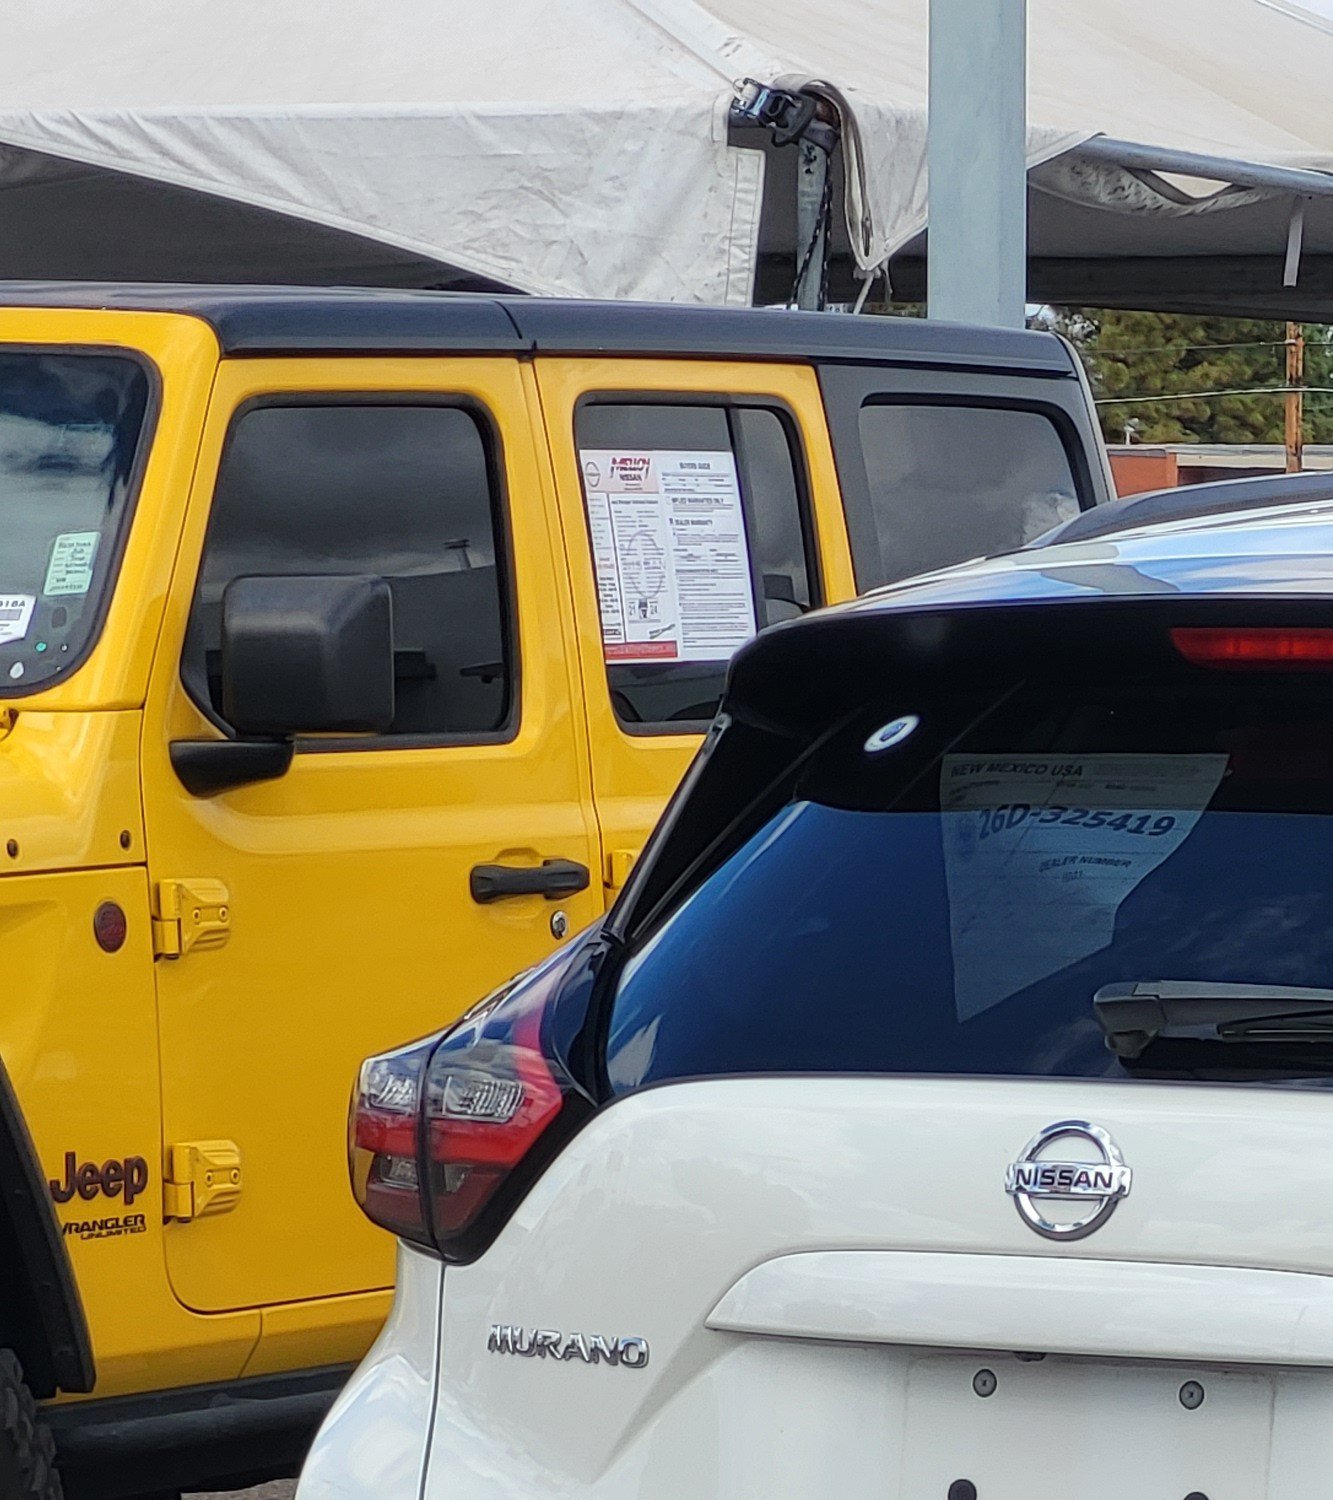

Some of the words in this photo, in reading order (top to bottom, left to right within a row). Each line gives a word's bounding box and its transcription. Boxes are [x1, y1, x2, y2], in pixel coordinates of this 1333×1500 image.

[951, 762, 984, 777] NEW
[986, 762, 1048, 775] MEXICO
[1050, 763, 1083, 777] USA
[49, 1151, 148, 1205] Jeep
[1014, 1168, 1113, 1188] NISSAN
[80, 1226, 147, 1240] UNLIMITED
[487, 1324, 650, 1369] MURANO
